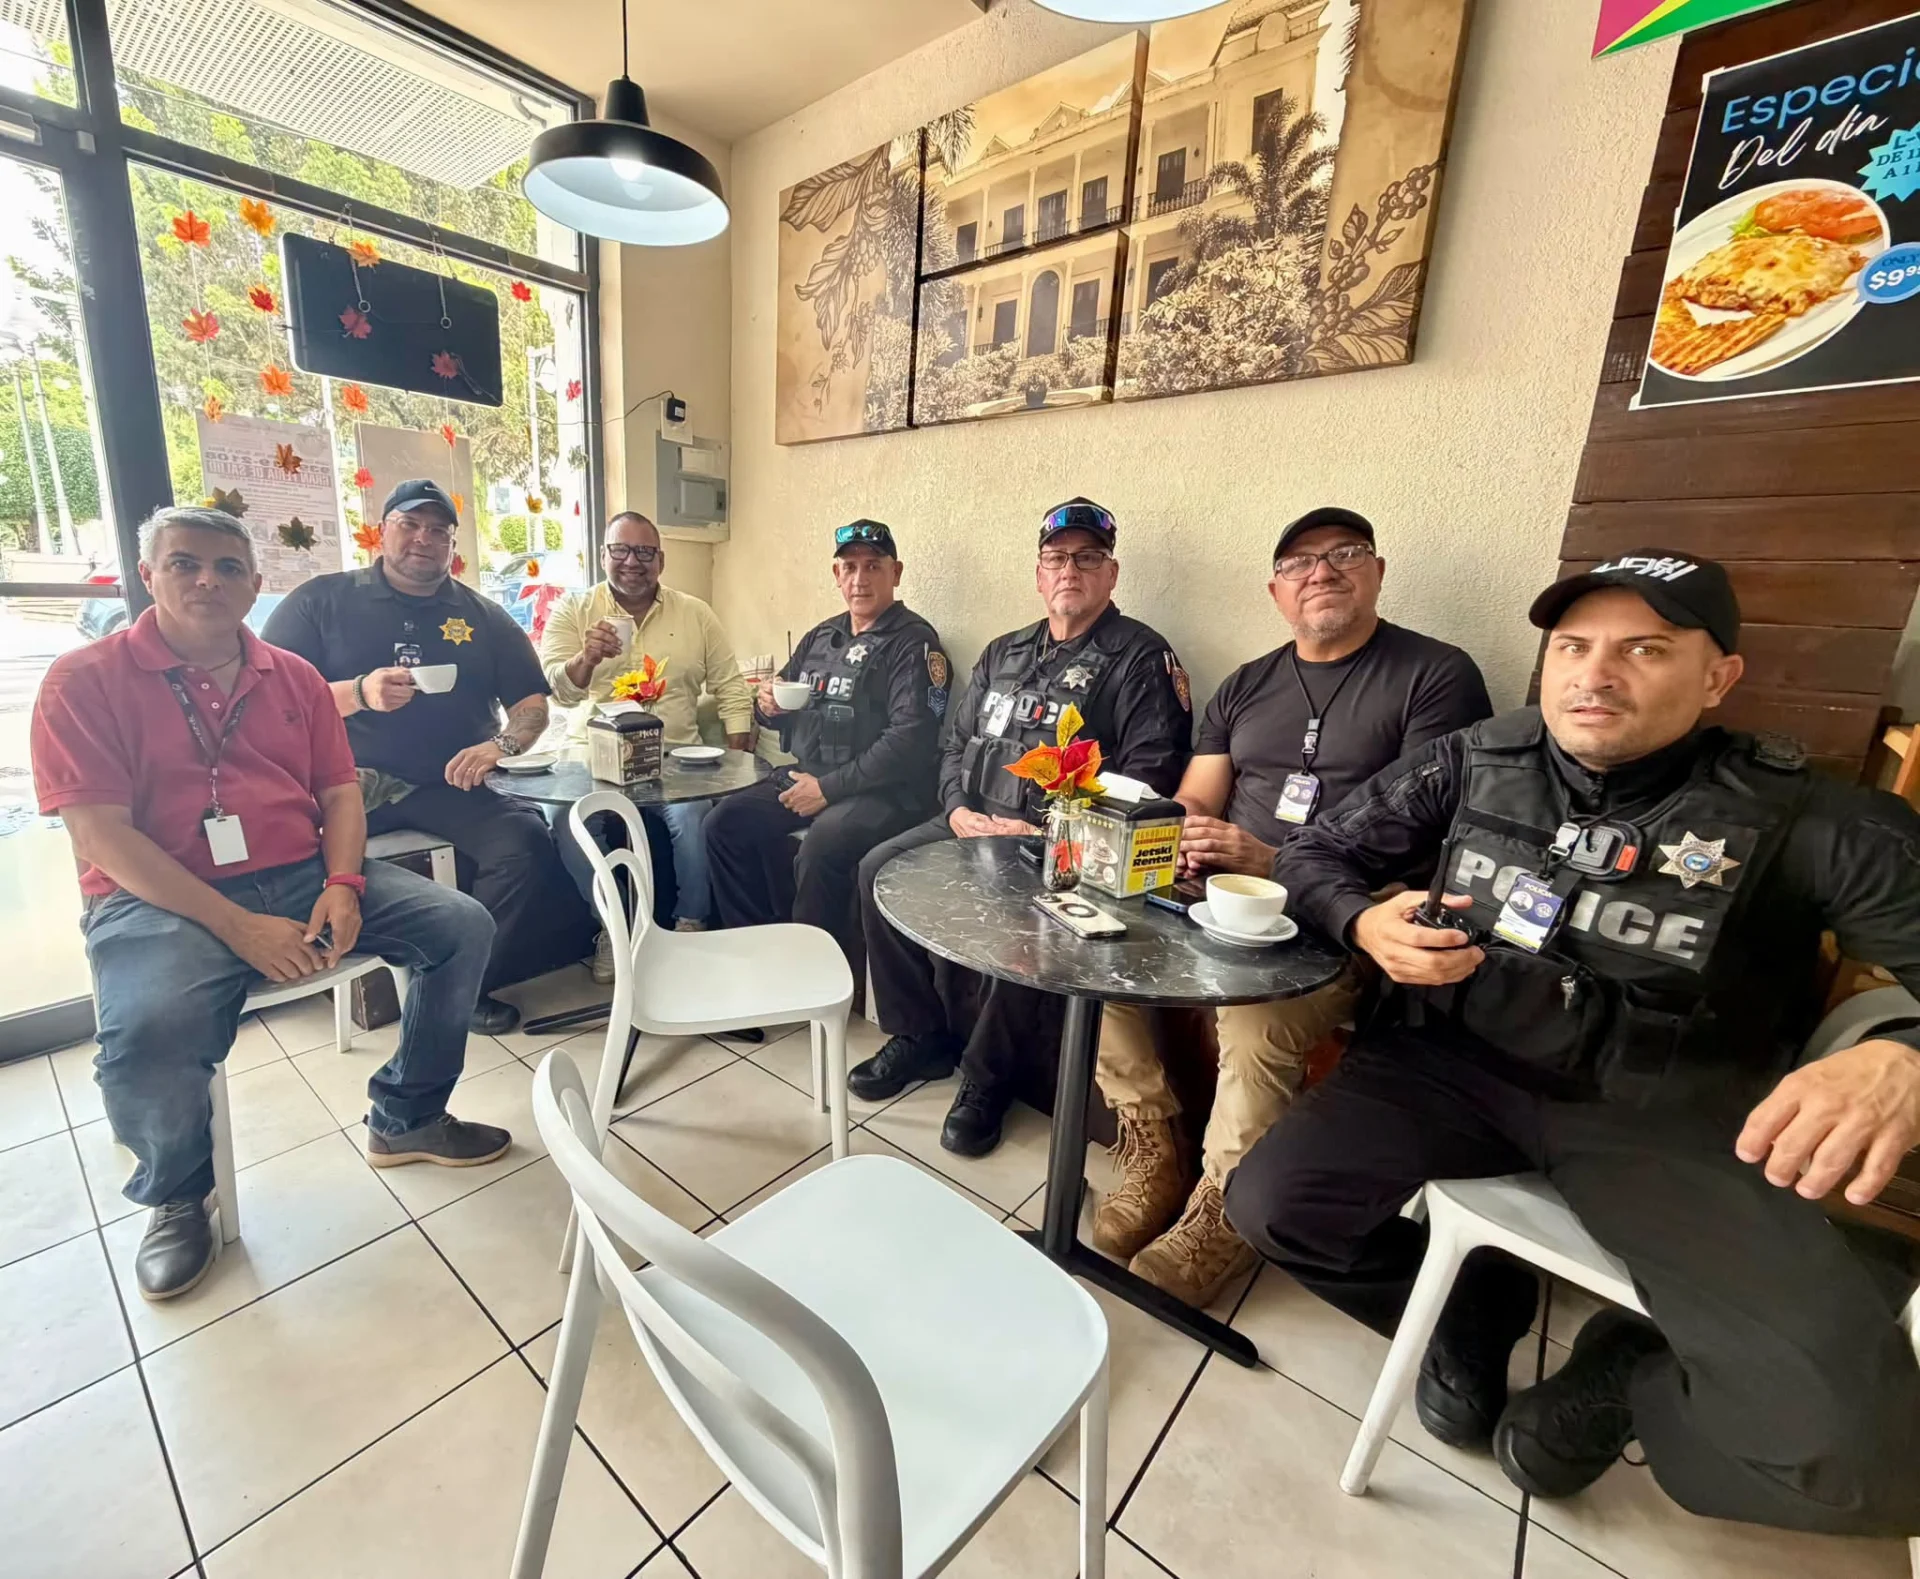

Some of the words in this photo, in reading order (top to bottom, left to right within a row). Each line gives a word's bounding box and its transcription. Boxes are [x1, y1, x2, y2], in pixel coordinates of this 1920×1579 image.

[1718, 116, 1813, 190] Del
[1876, 151, 1903, 166] DE
[1882, 167, 1897, 179] A
[1902, 165, 1910, 176] 1
[1136, 845, 1172, 857] Jetski
[1133, 854, 1173, 867] Rental
